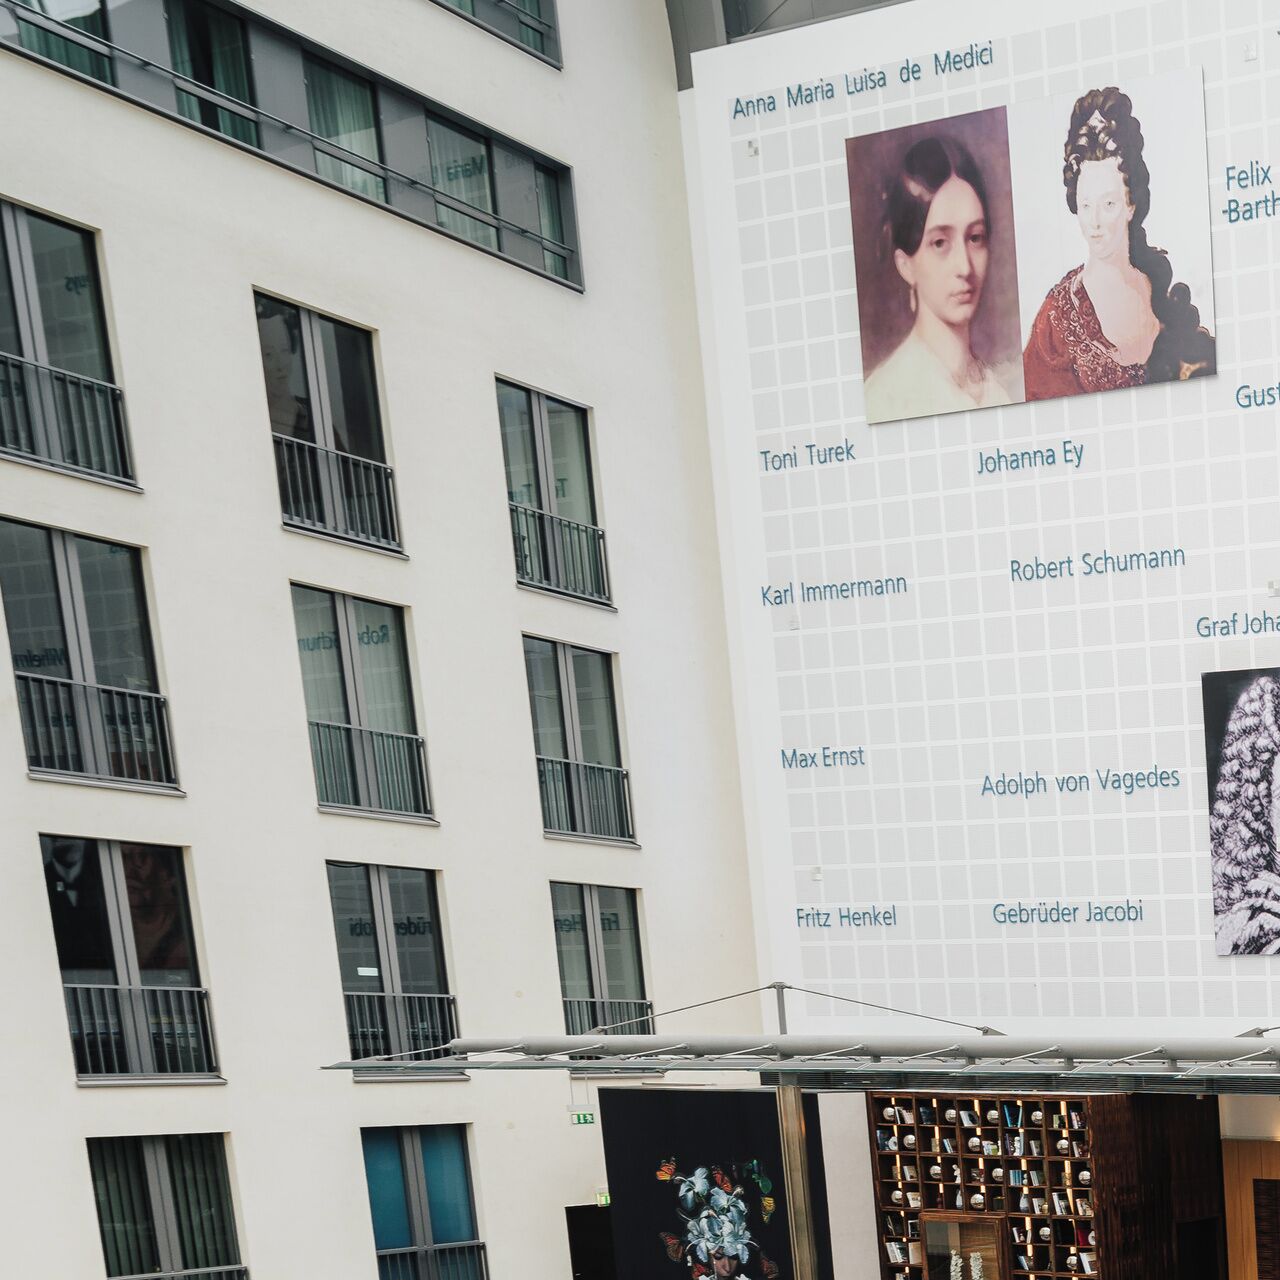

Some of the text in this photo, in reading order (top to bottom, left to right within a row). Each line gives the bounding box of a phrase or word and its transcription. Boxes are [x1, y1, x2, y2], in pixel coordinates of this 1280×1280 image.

[732, 41, 993, 119] Anna Maria Luisa de Medici
[1225, 160, 1272, 189] Felix
[761, 439, 854, 472] Toni Turek
[978, 439, 1084, 475] Johanna Ey
[1010, 548, 1185, 581] Robert Schumann
[760, 576, 907, 607] Karl Immermann
[1195, 612, 1238, 638] Graf
[780, 746, 865, 769] Max Ernst
[981, 767, 1181, 798] Adolph von Vagedes
[795, 906, 897, 929] Fritz Henkel
[992, 902, 1144, 925] Gebrüder Jacobi
